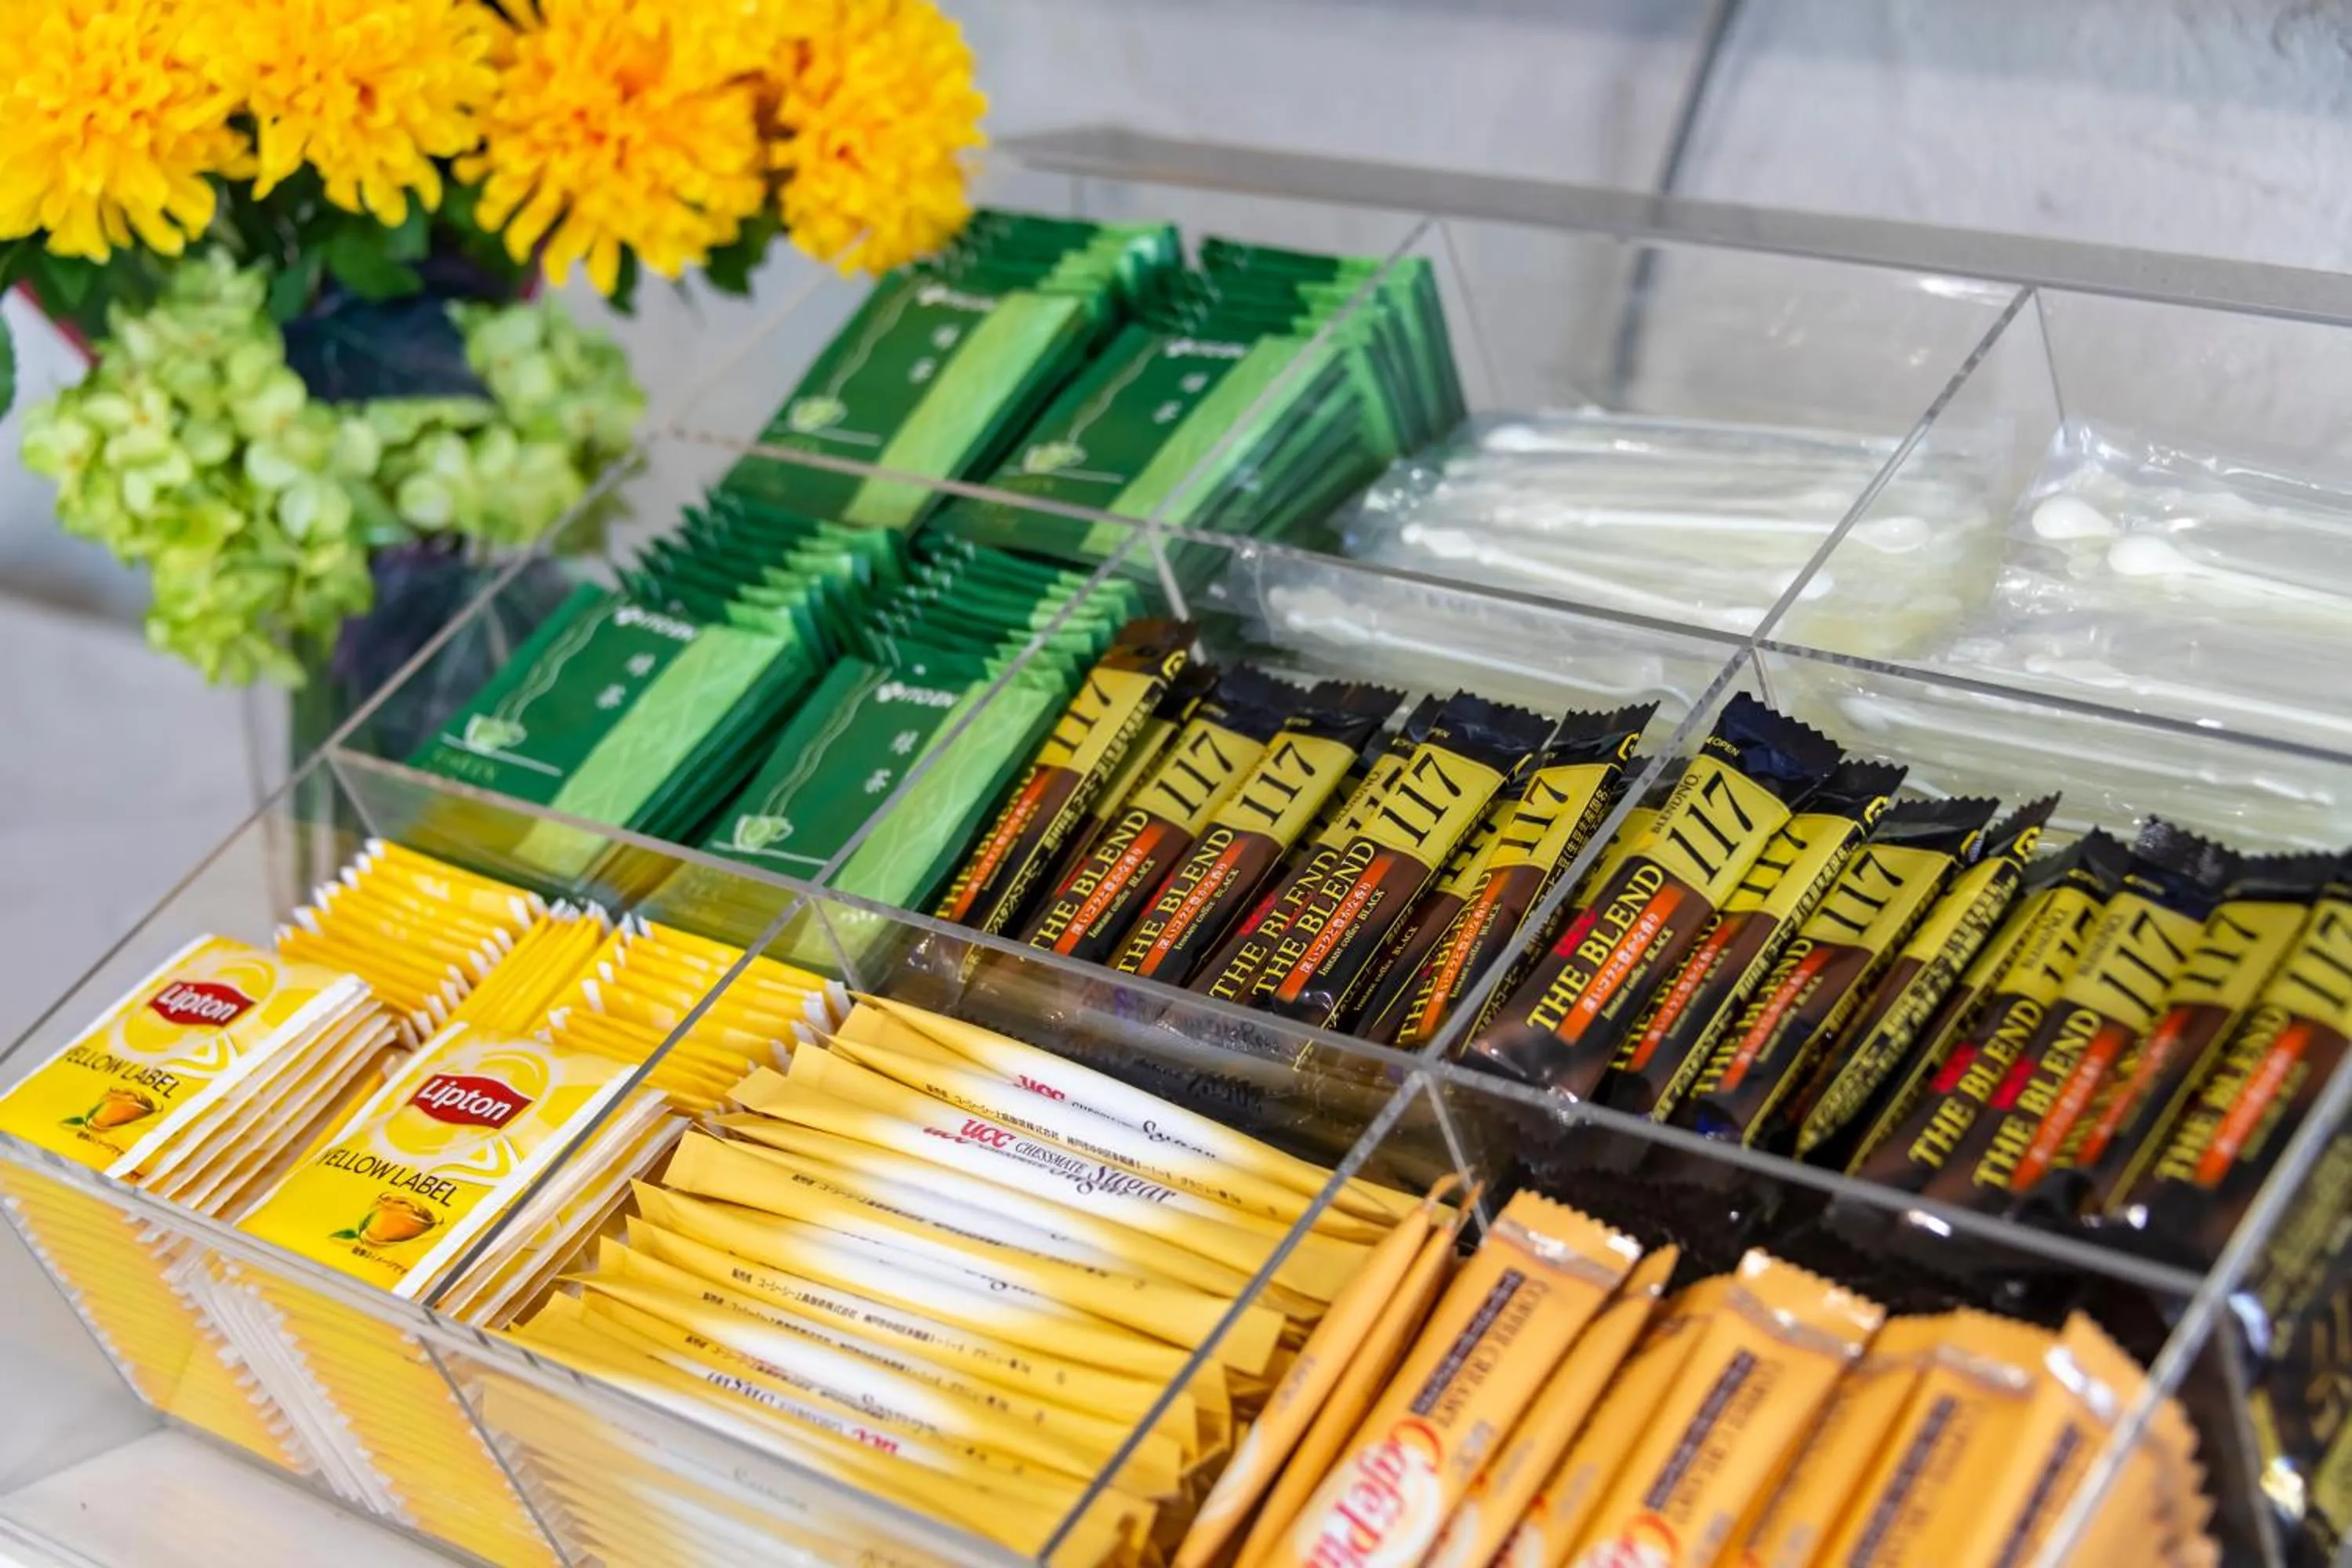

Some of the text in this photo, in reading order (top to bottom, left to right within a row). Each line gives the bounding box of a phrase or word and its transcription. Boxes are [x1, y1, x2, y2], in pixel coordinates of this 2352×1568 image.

[1154, 729, 1233, 819] 117
[1238, 741, 1316, 826] 117
[1711, 737, 1741, 757] OPEN
[1378, 752, 1462, 848] 117
[1496, 776, 1569, 856] 117
[1667, 770, 1754, 885] 117
[1029, 810, 1149, 950] THE BLEND
[1116, 827, 1234, 974] THE BLEND
[1127, 856, 1156, 888] BLACK
[1211, 866, 1241, 899] BLACK
[1356, 887, 1385, 921] BLACK
[1819, 851, 1904, 937] 117
[1252, 937, 1308, 996] THE
[1295, 841, 1374, 936] BLEND
[1526, 864, 1664, 1032] THE BLEND
[2180, 909, 2260, 988] 117
[156, 982, 238, 1022] Lipton
[1208, 942, 1268, 1000] THE
[2099, 909, 2187, 1019] 117
[64, 1046, 180, 1098] ELLOW LABEL
[416, 1077, 512, 1121] Lipton
[1907, 1097, 1976, 1170] THE
[1958, 1000, 2043, 1103] BLEND
[1972, 1114, 2038, 1190] THE
[2016, 1008, 2103, 1117] BLEND
[315, 1149, 458, 1207] YELLOW LABEL
[1015, 1140, 1089, 1174] CHESSMATE
[1088, 1165, 1178, 1203] Sugar
